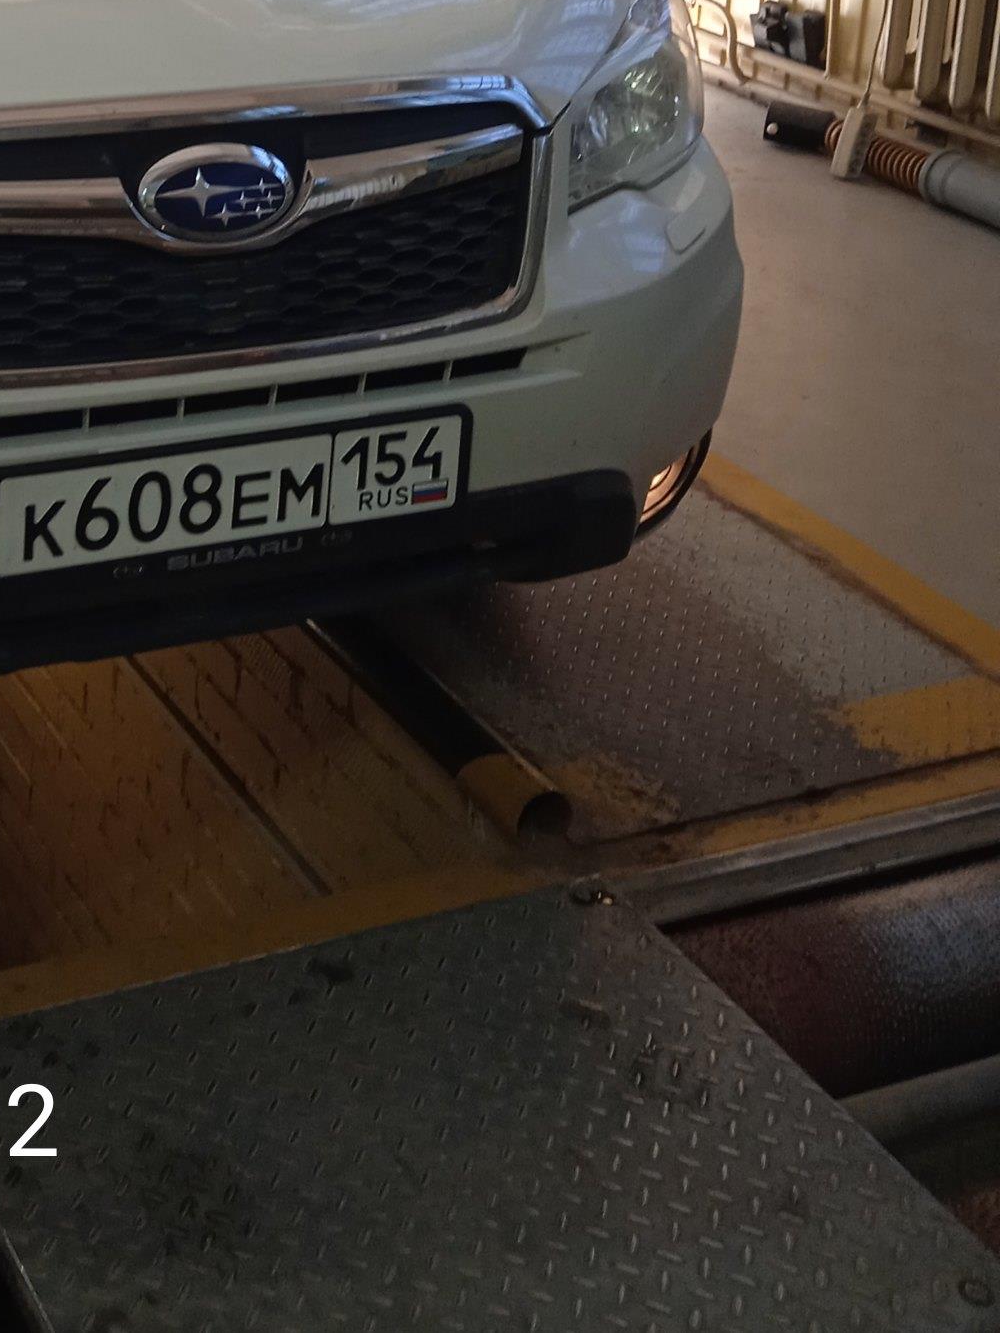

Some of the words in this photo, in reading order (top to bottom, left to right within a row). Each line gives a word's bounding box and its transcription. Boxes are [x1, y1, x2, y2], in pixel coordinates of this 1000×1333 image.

[23, 463, 324, 561] К608ЕМ
[341, 426, 442, 491] 154
[359, 486, 409, 511] RUS
[166, 535, 304, 571] SUBARU
